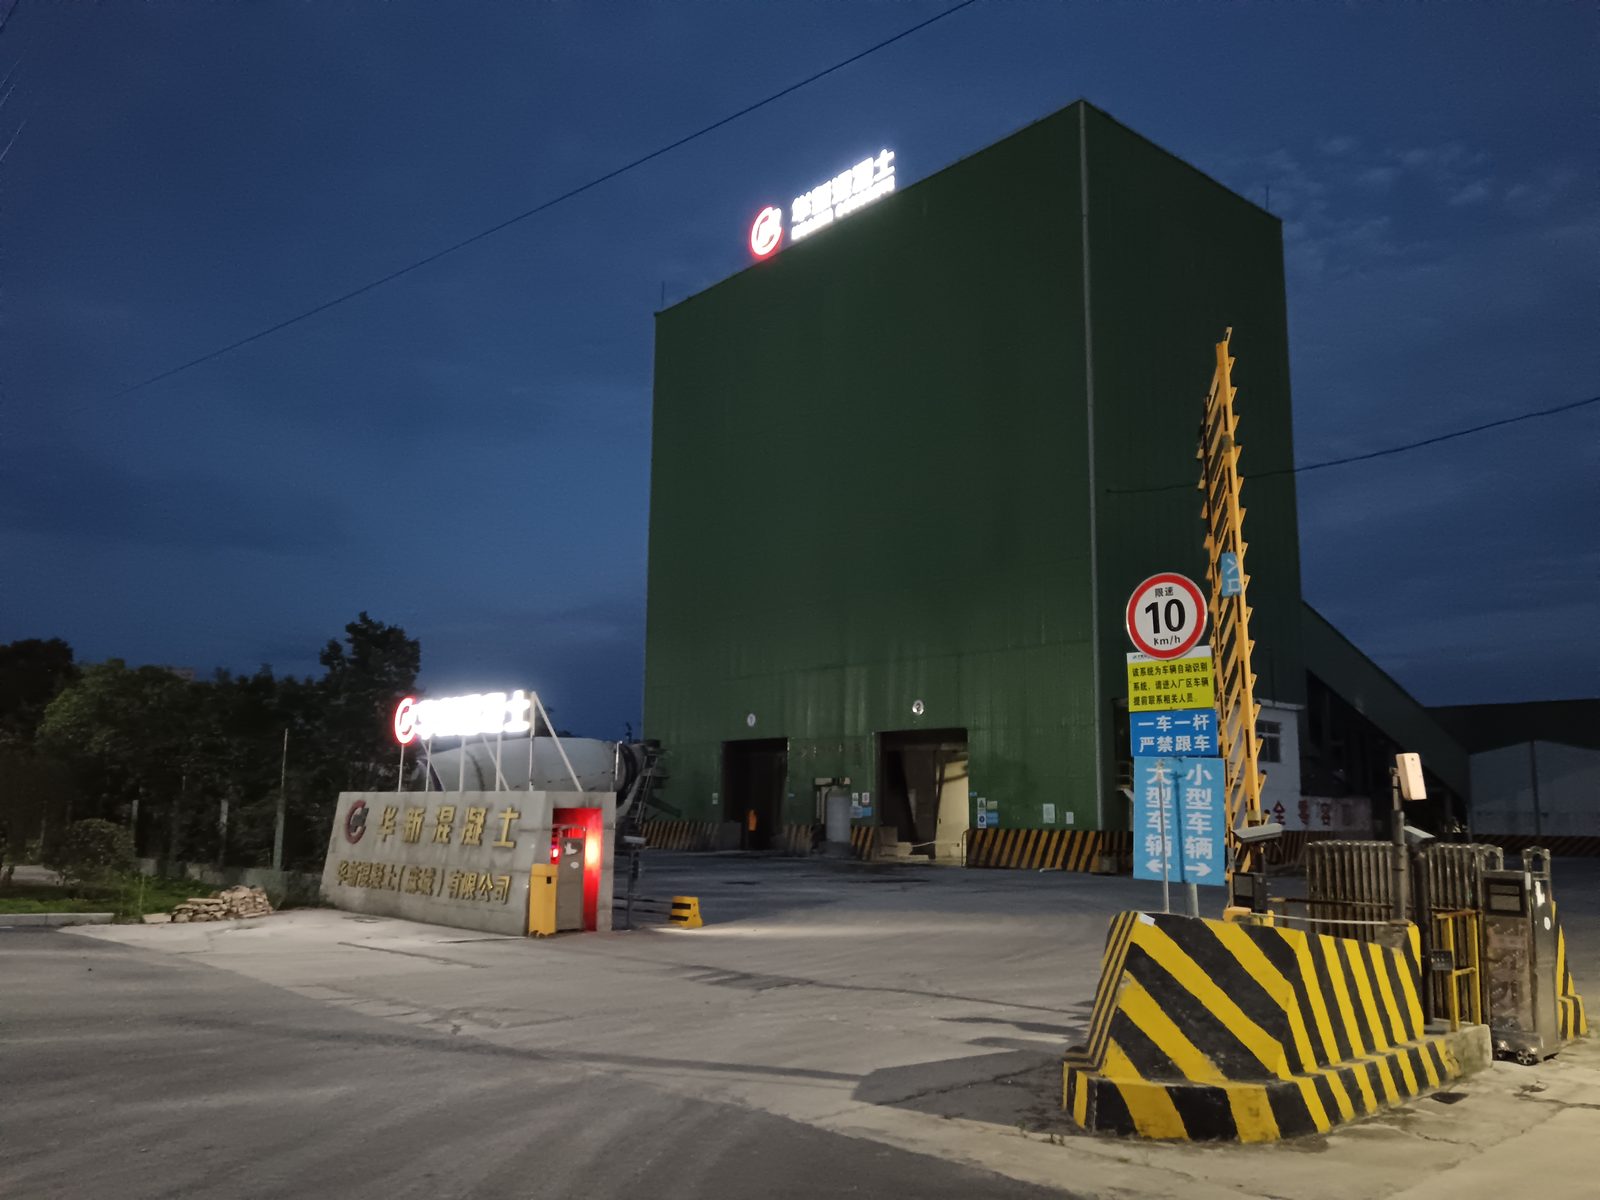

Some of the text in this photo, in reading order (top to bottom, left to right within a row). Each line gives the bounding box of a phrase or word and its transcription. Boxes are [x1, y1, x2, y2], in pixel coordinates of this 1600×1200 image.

[1154, 586, 1174, 598] 限速
[1145, 599, 1186, 634] 10
[1153, 635, 1181, 646] km/h
[1132, 662, 1208, 677] 该系统为车辆自动识别
[1138, 714, 1210, 732] 一车一杆
[1139, 735, 1210, 753] 严禁跟车
[1145, 762, 1173, 858] 大型车辆
[1185, 764, 1213, 860] 小型车辆
[377, 805, 520, 849] 华新混凝土
